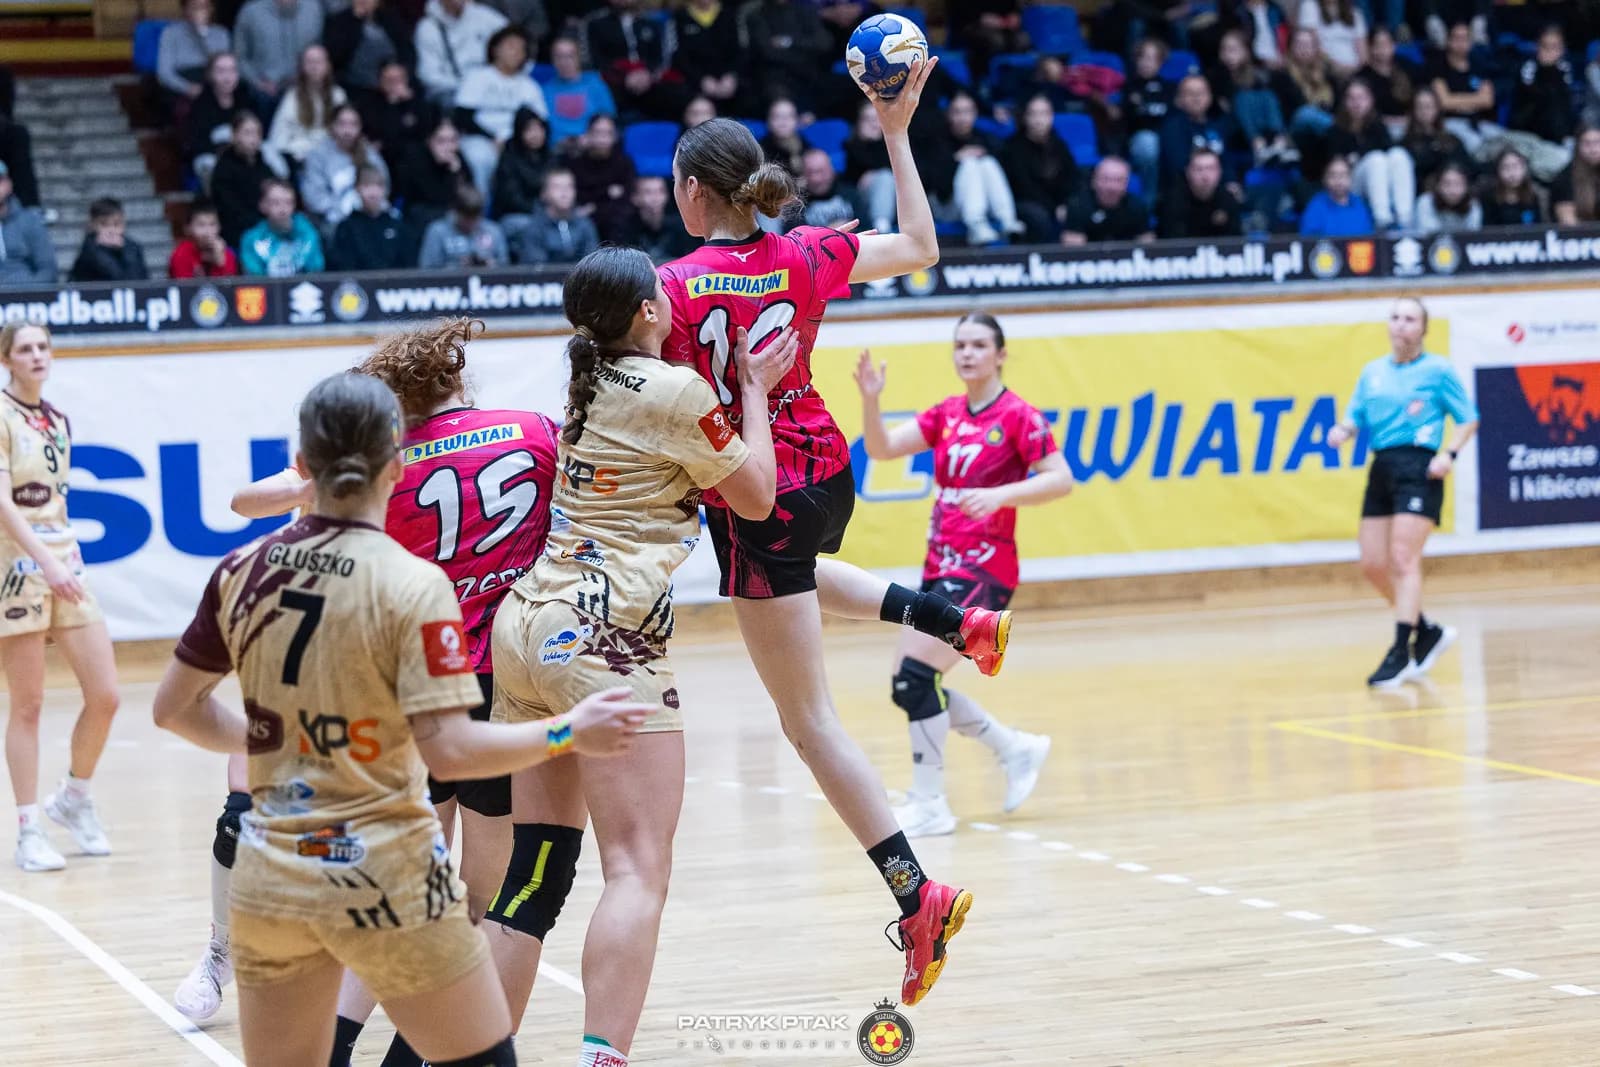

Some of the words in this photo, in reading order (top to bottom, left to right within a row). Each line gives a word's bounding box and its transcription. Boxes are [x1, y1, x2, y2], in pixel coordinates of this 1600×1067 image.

[713, 273, 783, 293] LEWIATAN
[943, 242, 1302, 289] www.koronahandball.pl
[0, 287, 182, 331] andball.pl
[425, 426, 514, 457] LEWIATAN
[1030, 389, 1371, 483] WIATA
[44, 445, 58, 473] 9
[947, 442, 983, 478] 17
[1508, 444, 1598, 471] Zawsze
[416, 449, 539, 561] 15
[278, 588, 326, 687] 7
